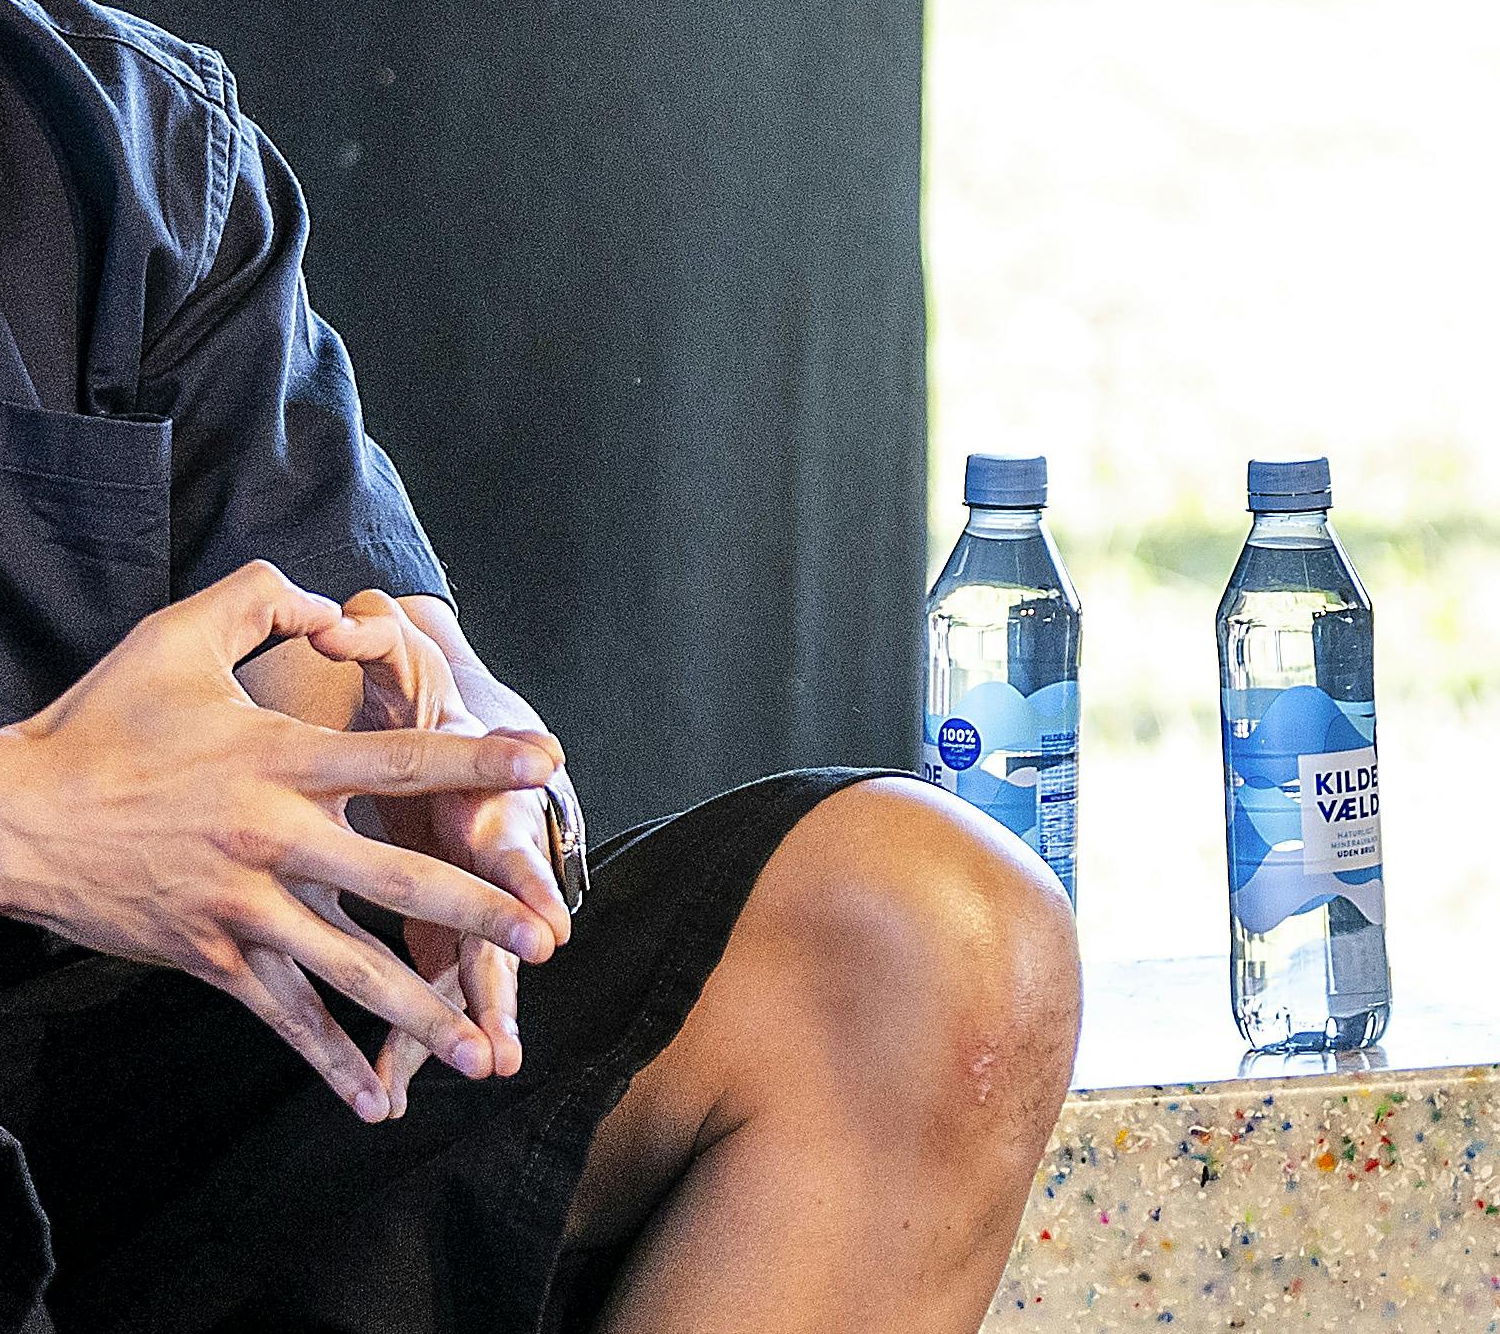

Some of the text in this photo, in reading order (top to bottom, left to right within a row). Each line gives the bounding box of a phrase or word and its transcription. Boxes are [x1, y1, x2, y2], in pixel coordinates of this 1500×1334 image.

[942, 728, 976, 743] 100%
[1315, 764, 1378, 796] KILDE
[1317, 793, 1380, 823] VÆLD
[1337, 848, 1359, 858] UDEN
